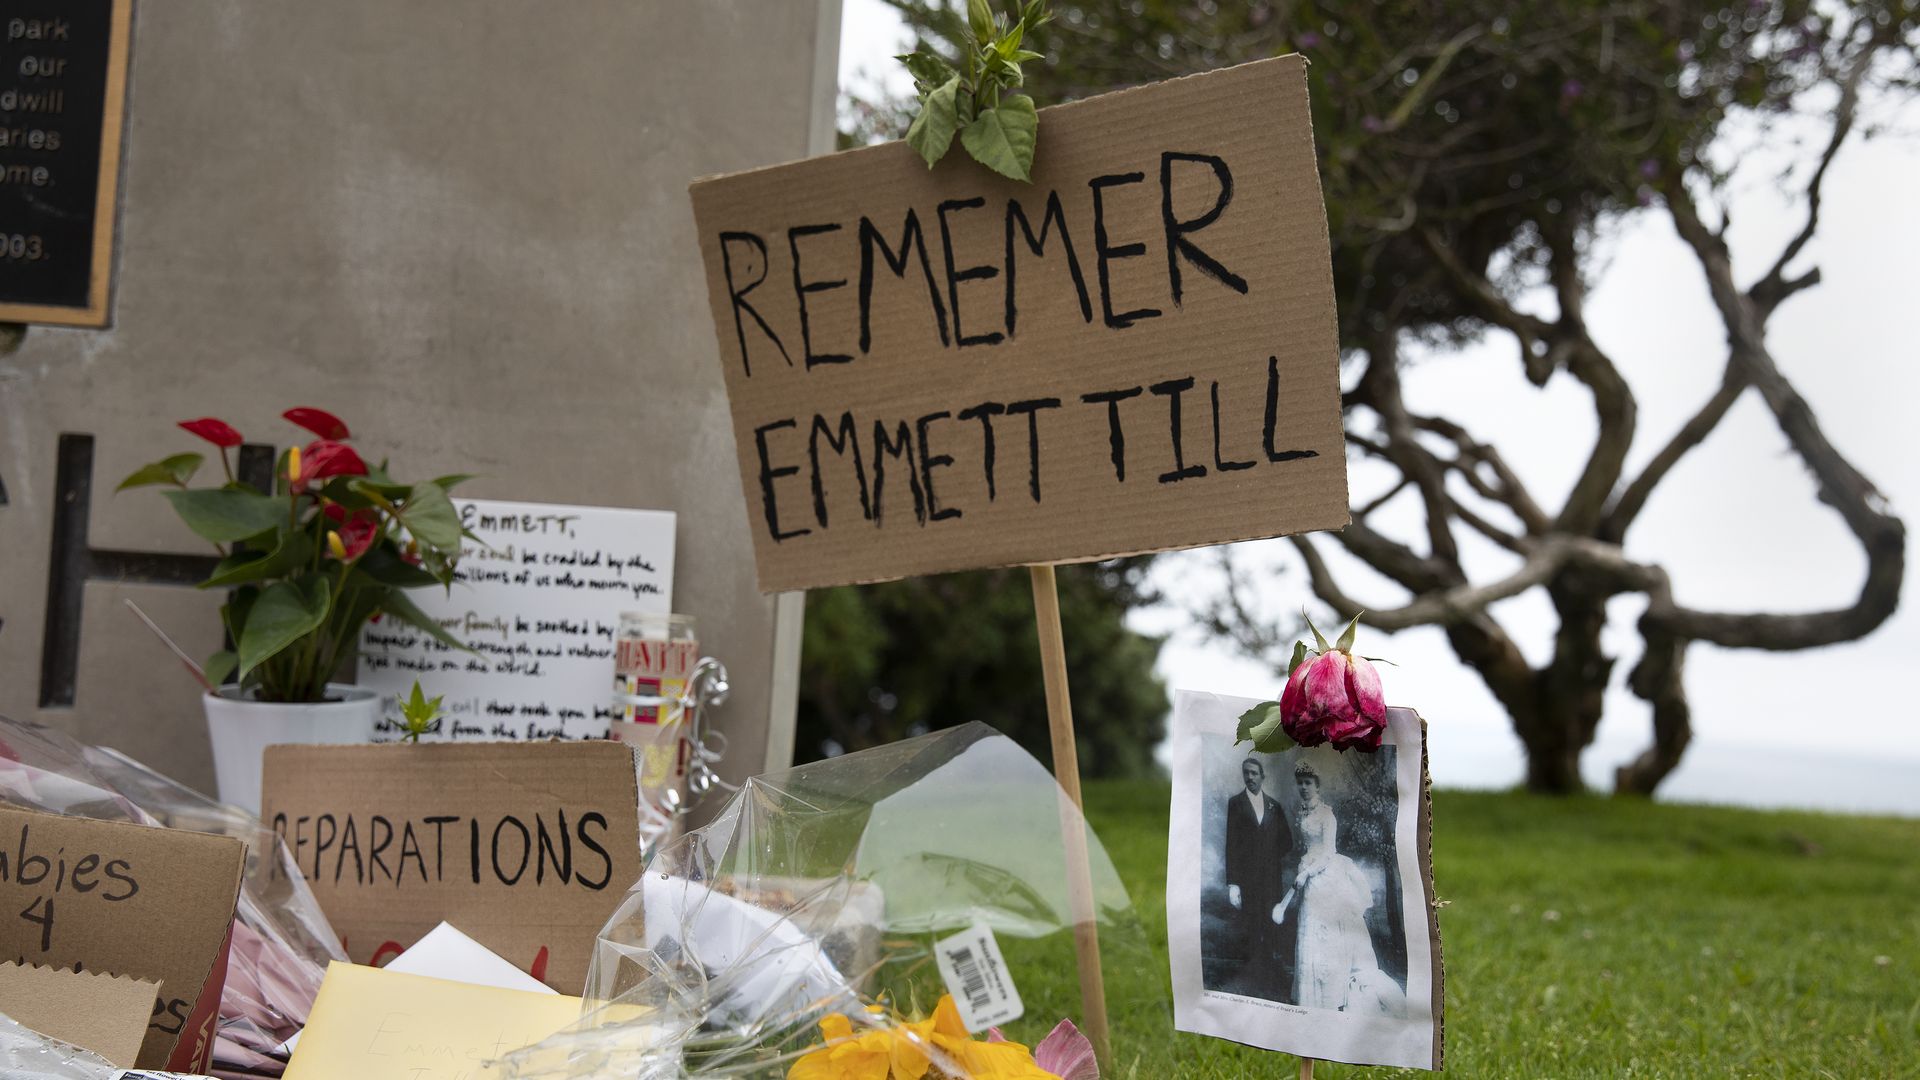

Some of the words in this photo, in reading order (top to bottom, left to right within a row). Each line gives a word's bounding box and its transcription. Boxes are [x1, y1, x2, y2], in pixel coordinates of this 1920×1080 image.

[8, 17, 70, 43] park
[20, 55, 67, 77] our
[719, 151, 1248, 378] REMEMER
[754, 397, 1062, 543] EMMETT
[1080, 355, 1319, 484] TILL
[522, 549, 537, 564] be
[543, 549, 602, 568] cradled
[607, 552, 623, 577] by
[627, 553, 656, 572] the
[514, 569, 530, 584] of
[588, 578, 630, 591] mourn
[465, 610, 509, 640] family
[516, 614, 529, 632] be
[536, 619, 588, 635] soothed
[537, 643, 561, 658] and
[396, 656, 436, 672] made
[466, 660, 489, 673] the
[452, 719, 486, 739] from
[492, 722, 517, 739] the
[558, 706, 586, 726] you
[271, 808, 613, 891] REPARATIONS
[20, 895, 54, 952] 4
